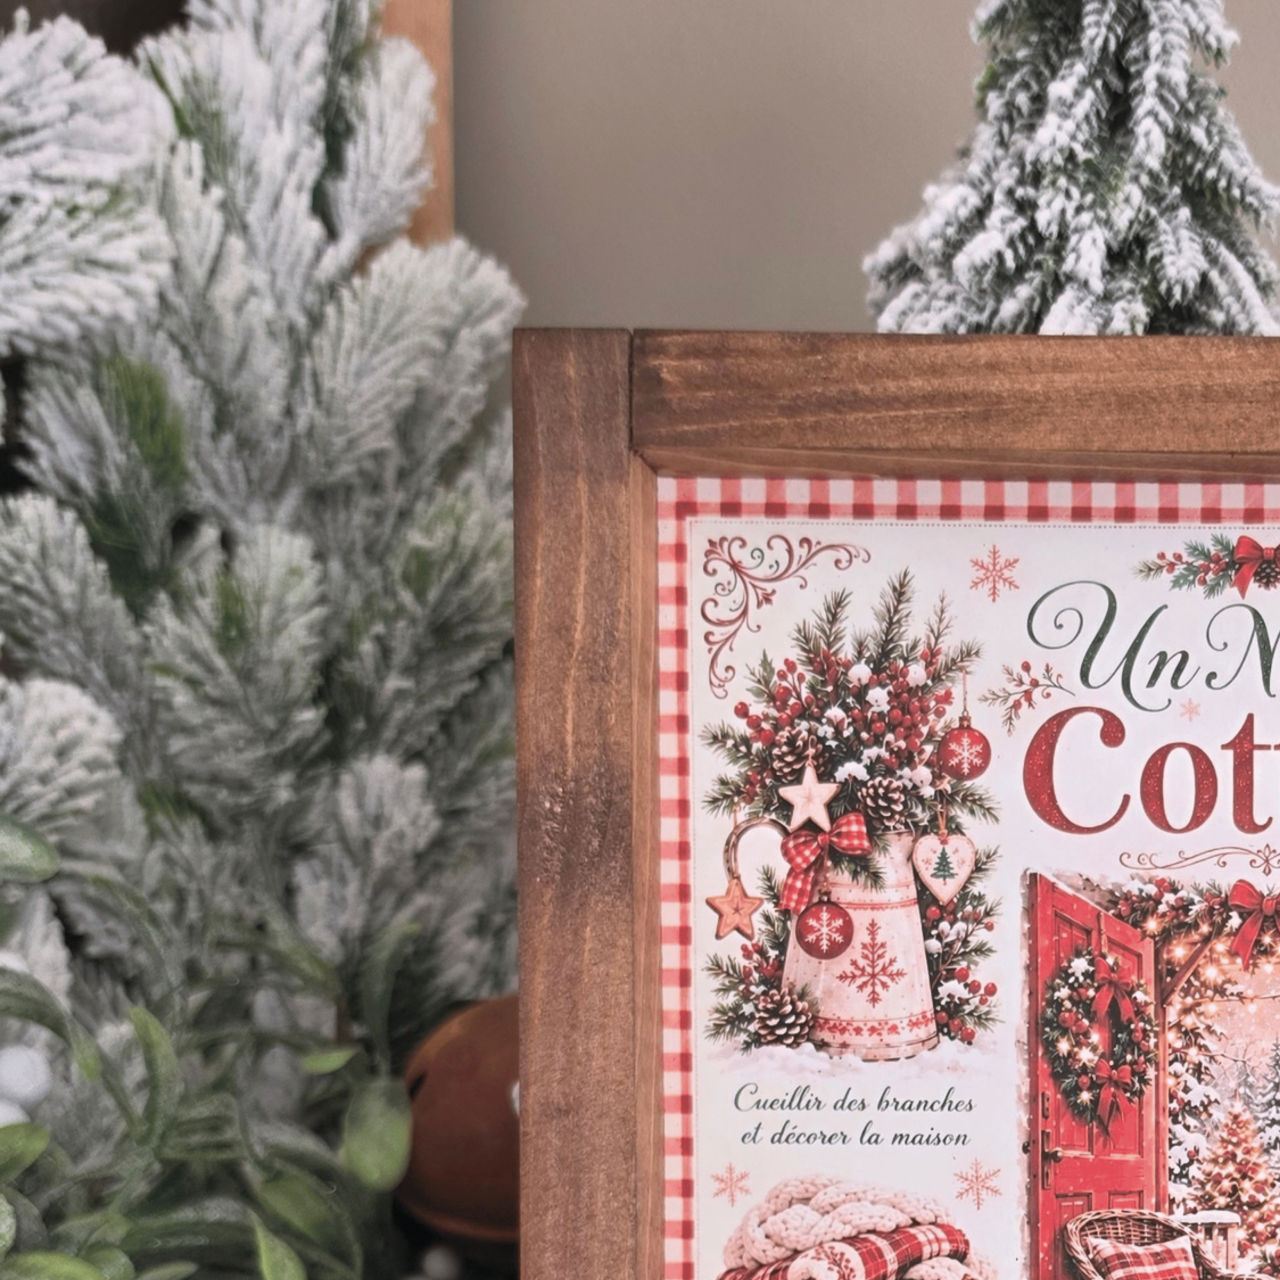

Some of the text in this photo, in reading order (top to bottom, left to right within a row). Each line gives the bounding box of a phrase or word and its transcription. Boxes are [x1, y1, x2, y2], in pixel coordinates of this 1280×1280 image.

[1026, 579, 1201, 712] Un
[734, 1082, 976, 1112] Cueillir des branches
[741, 1120, 971, 1146] et décorer la maison
